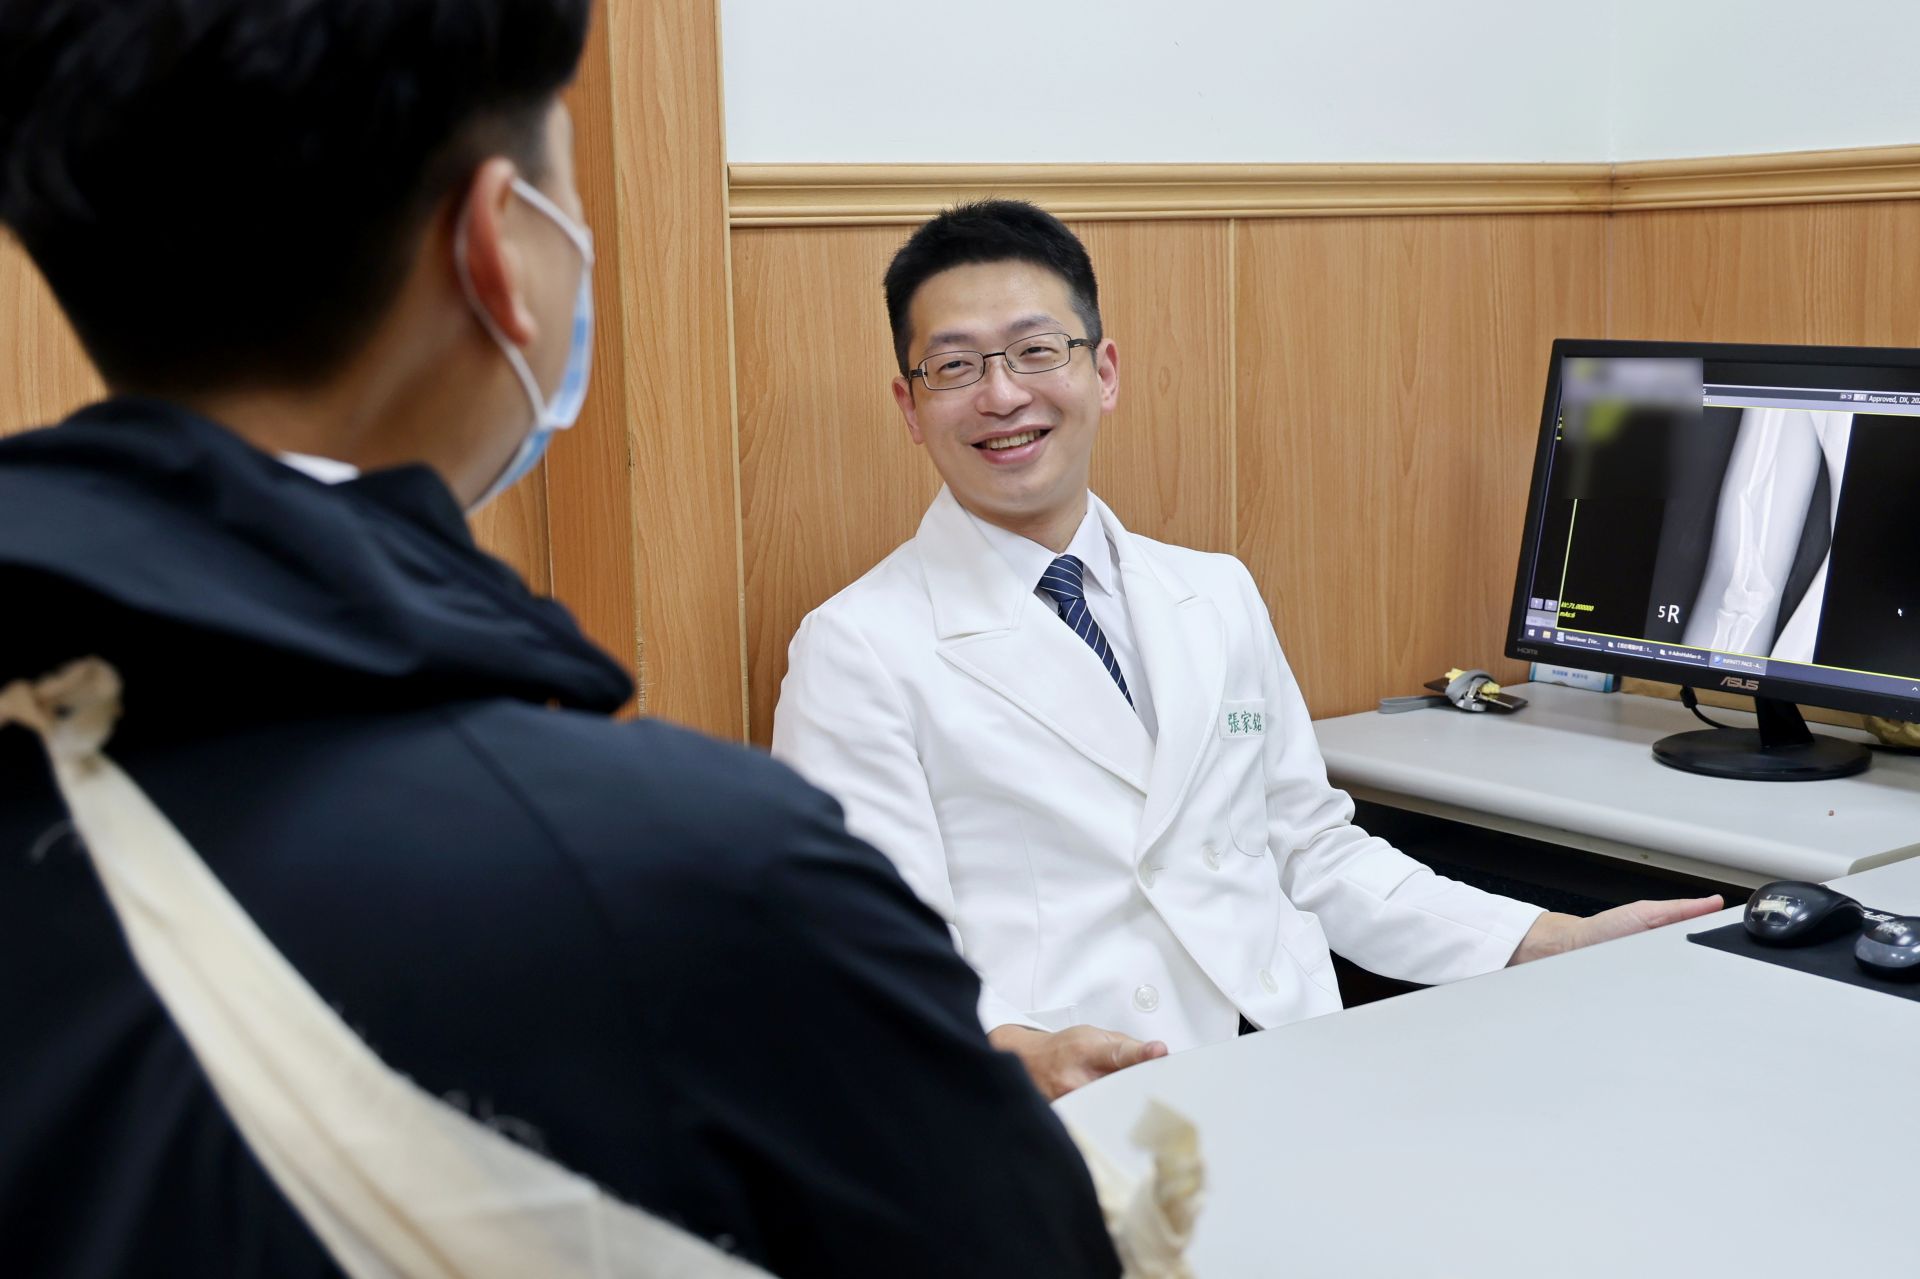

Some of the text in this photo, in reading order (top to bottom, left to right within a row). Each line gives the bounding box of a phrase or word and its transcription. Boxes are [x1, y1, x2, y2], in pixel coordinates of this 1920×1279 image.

[1720, 676, 1760, 691] ASUS
[1227, 710, 1262, 734] 張家銘
